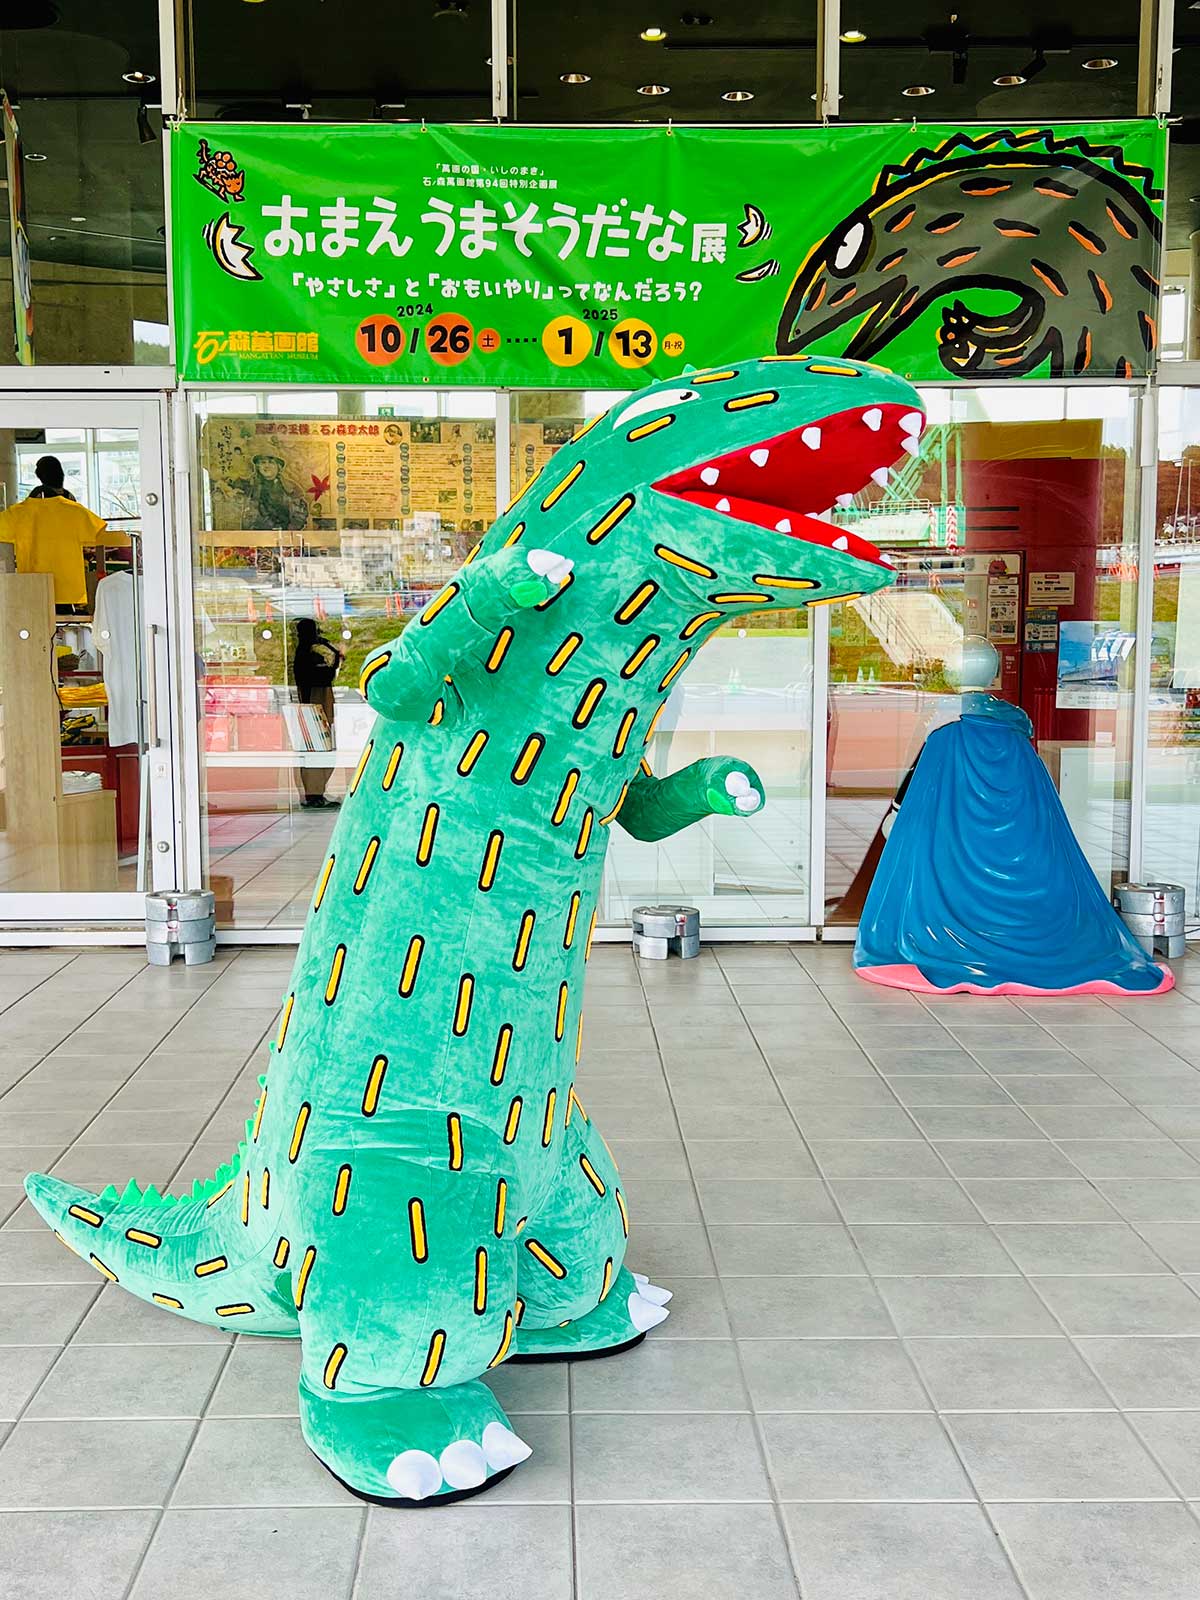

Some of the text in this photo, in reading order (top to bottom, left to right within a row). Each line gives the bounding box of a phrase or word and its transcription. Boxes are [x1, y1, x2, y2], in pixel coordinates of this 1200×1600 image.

[261, 194, 413, 258] おまえ
[396, 303, 434, 317] 2024
[582, 309, 618, 320] 2025
[482, 334, 495, 348] 土
